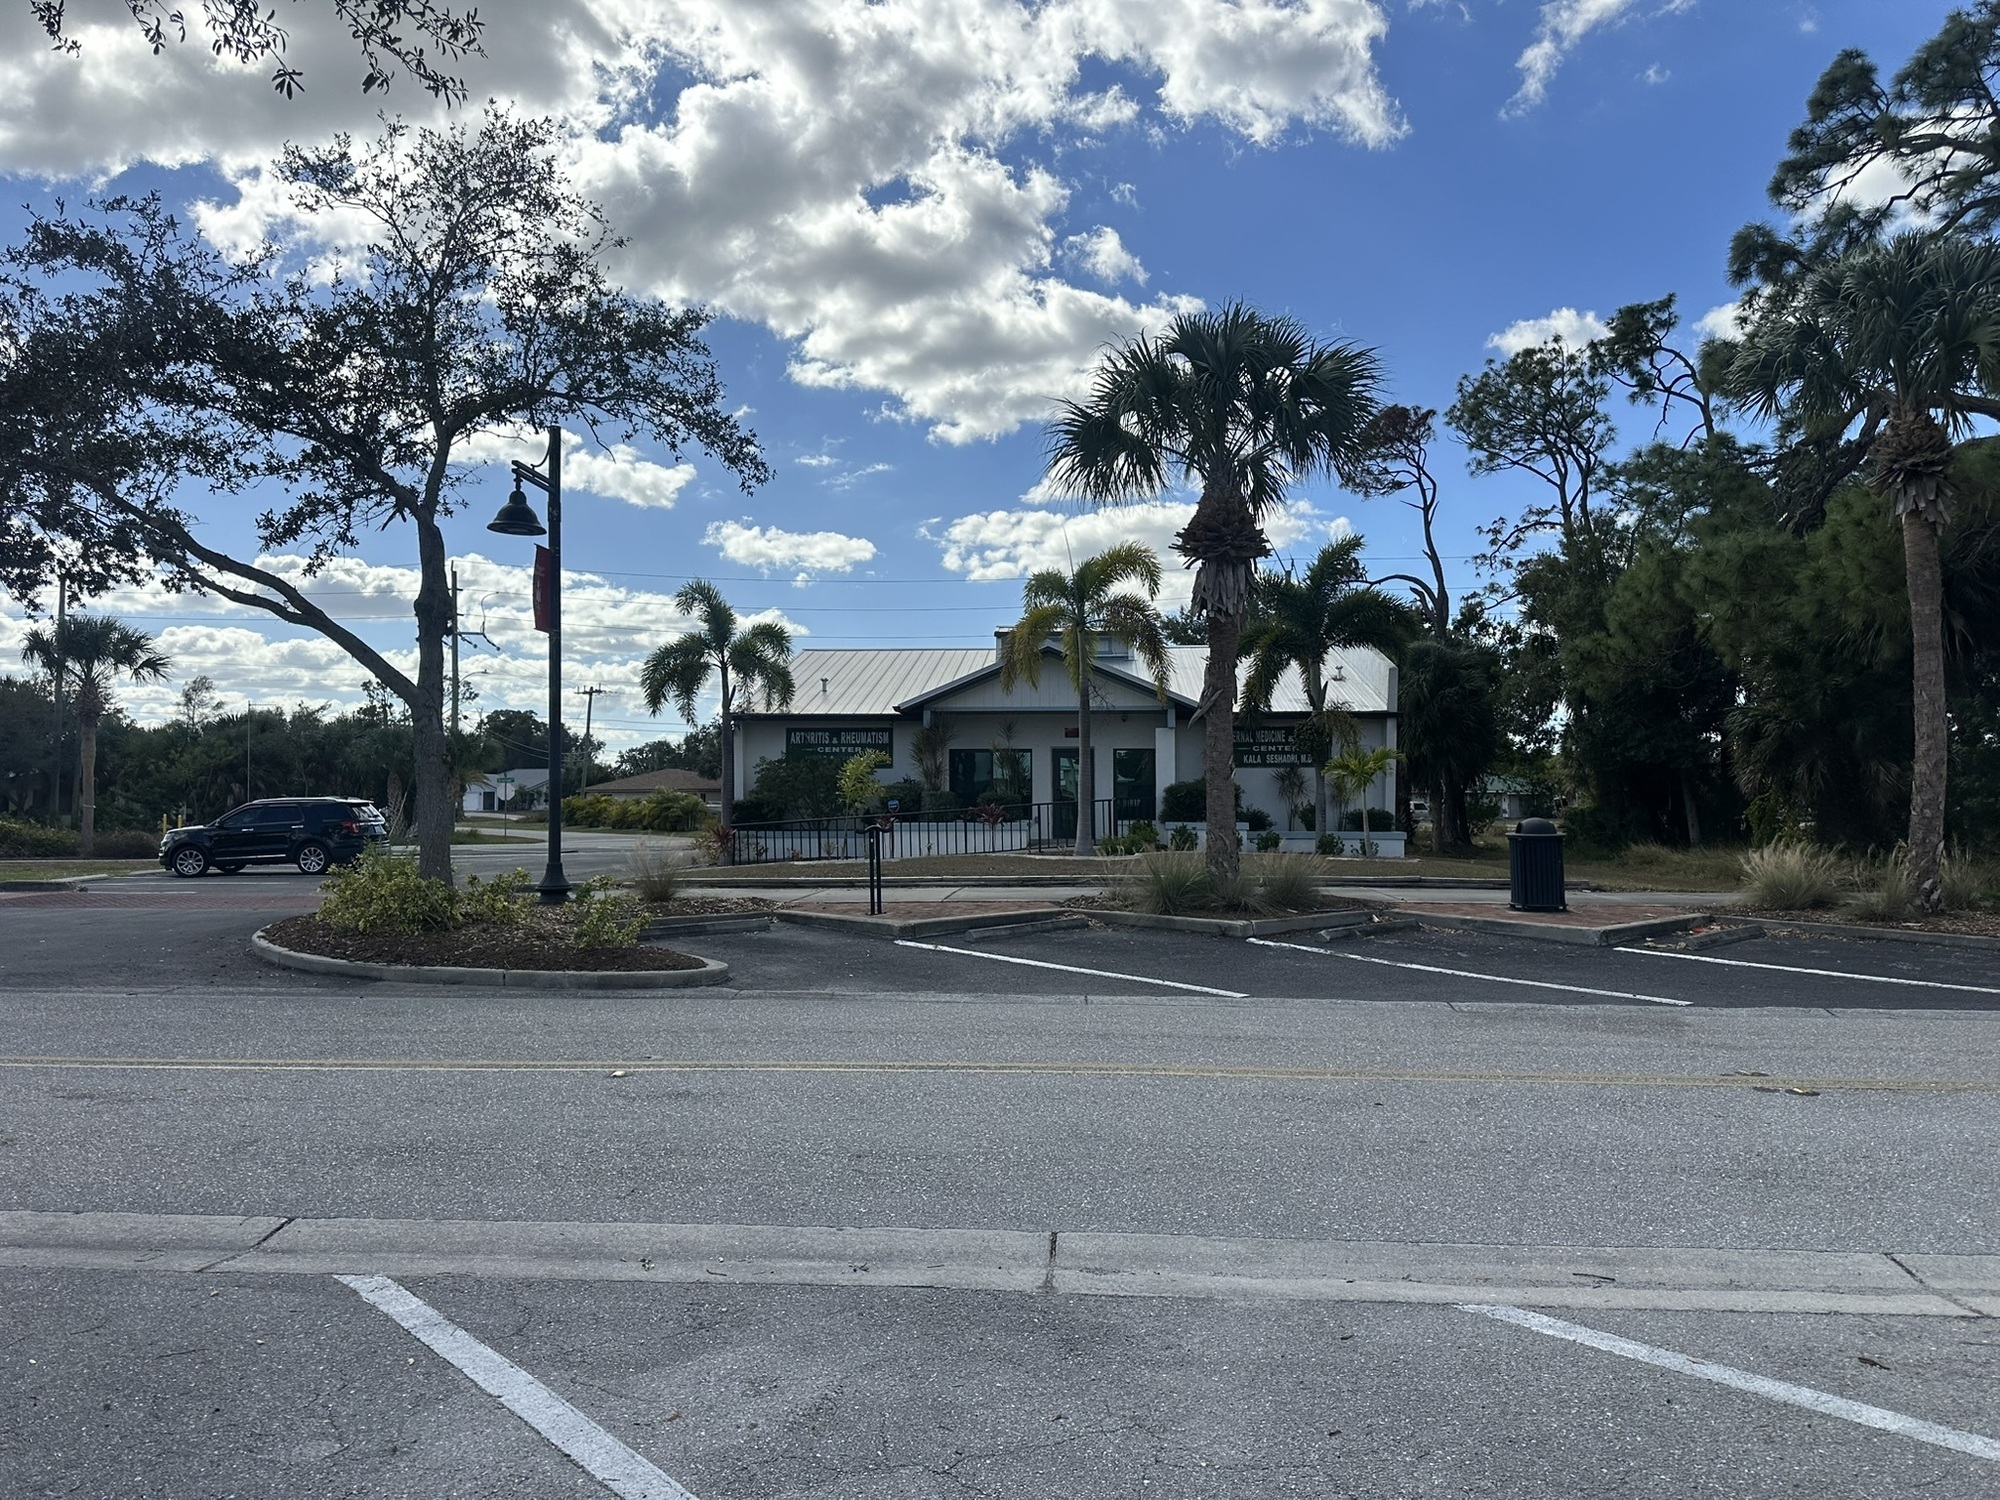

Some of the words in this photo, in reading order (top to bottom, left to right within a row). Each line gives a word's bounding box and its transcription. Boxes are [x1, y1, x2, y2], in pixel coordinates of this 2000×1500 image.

[790, 731, 830, 744] ARTHRITIS
[840, 731, 889, 744] RHEUMATISM
[1255, 730, 1286, 743] MEDICINE
[1243, 754, 1262, 764] KALA
